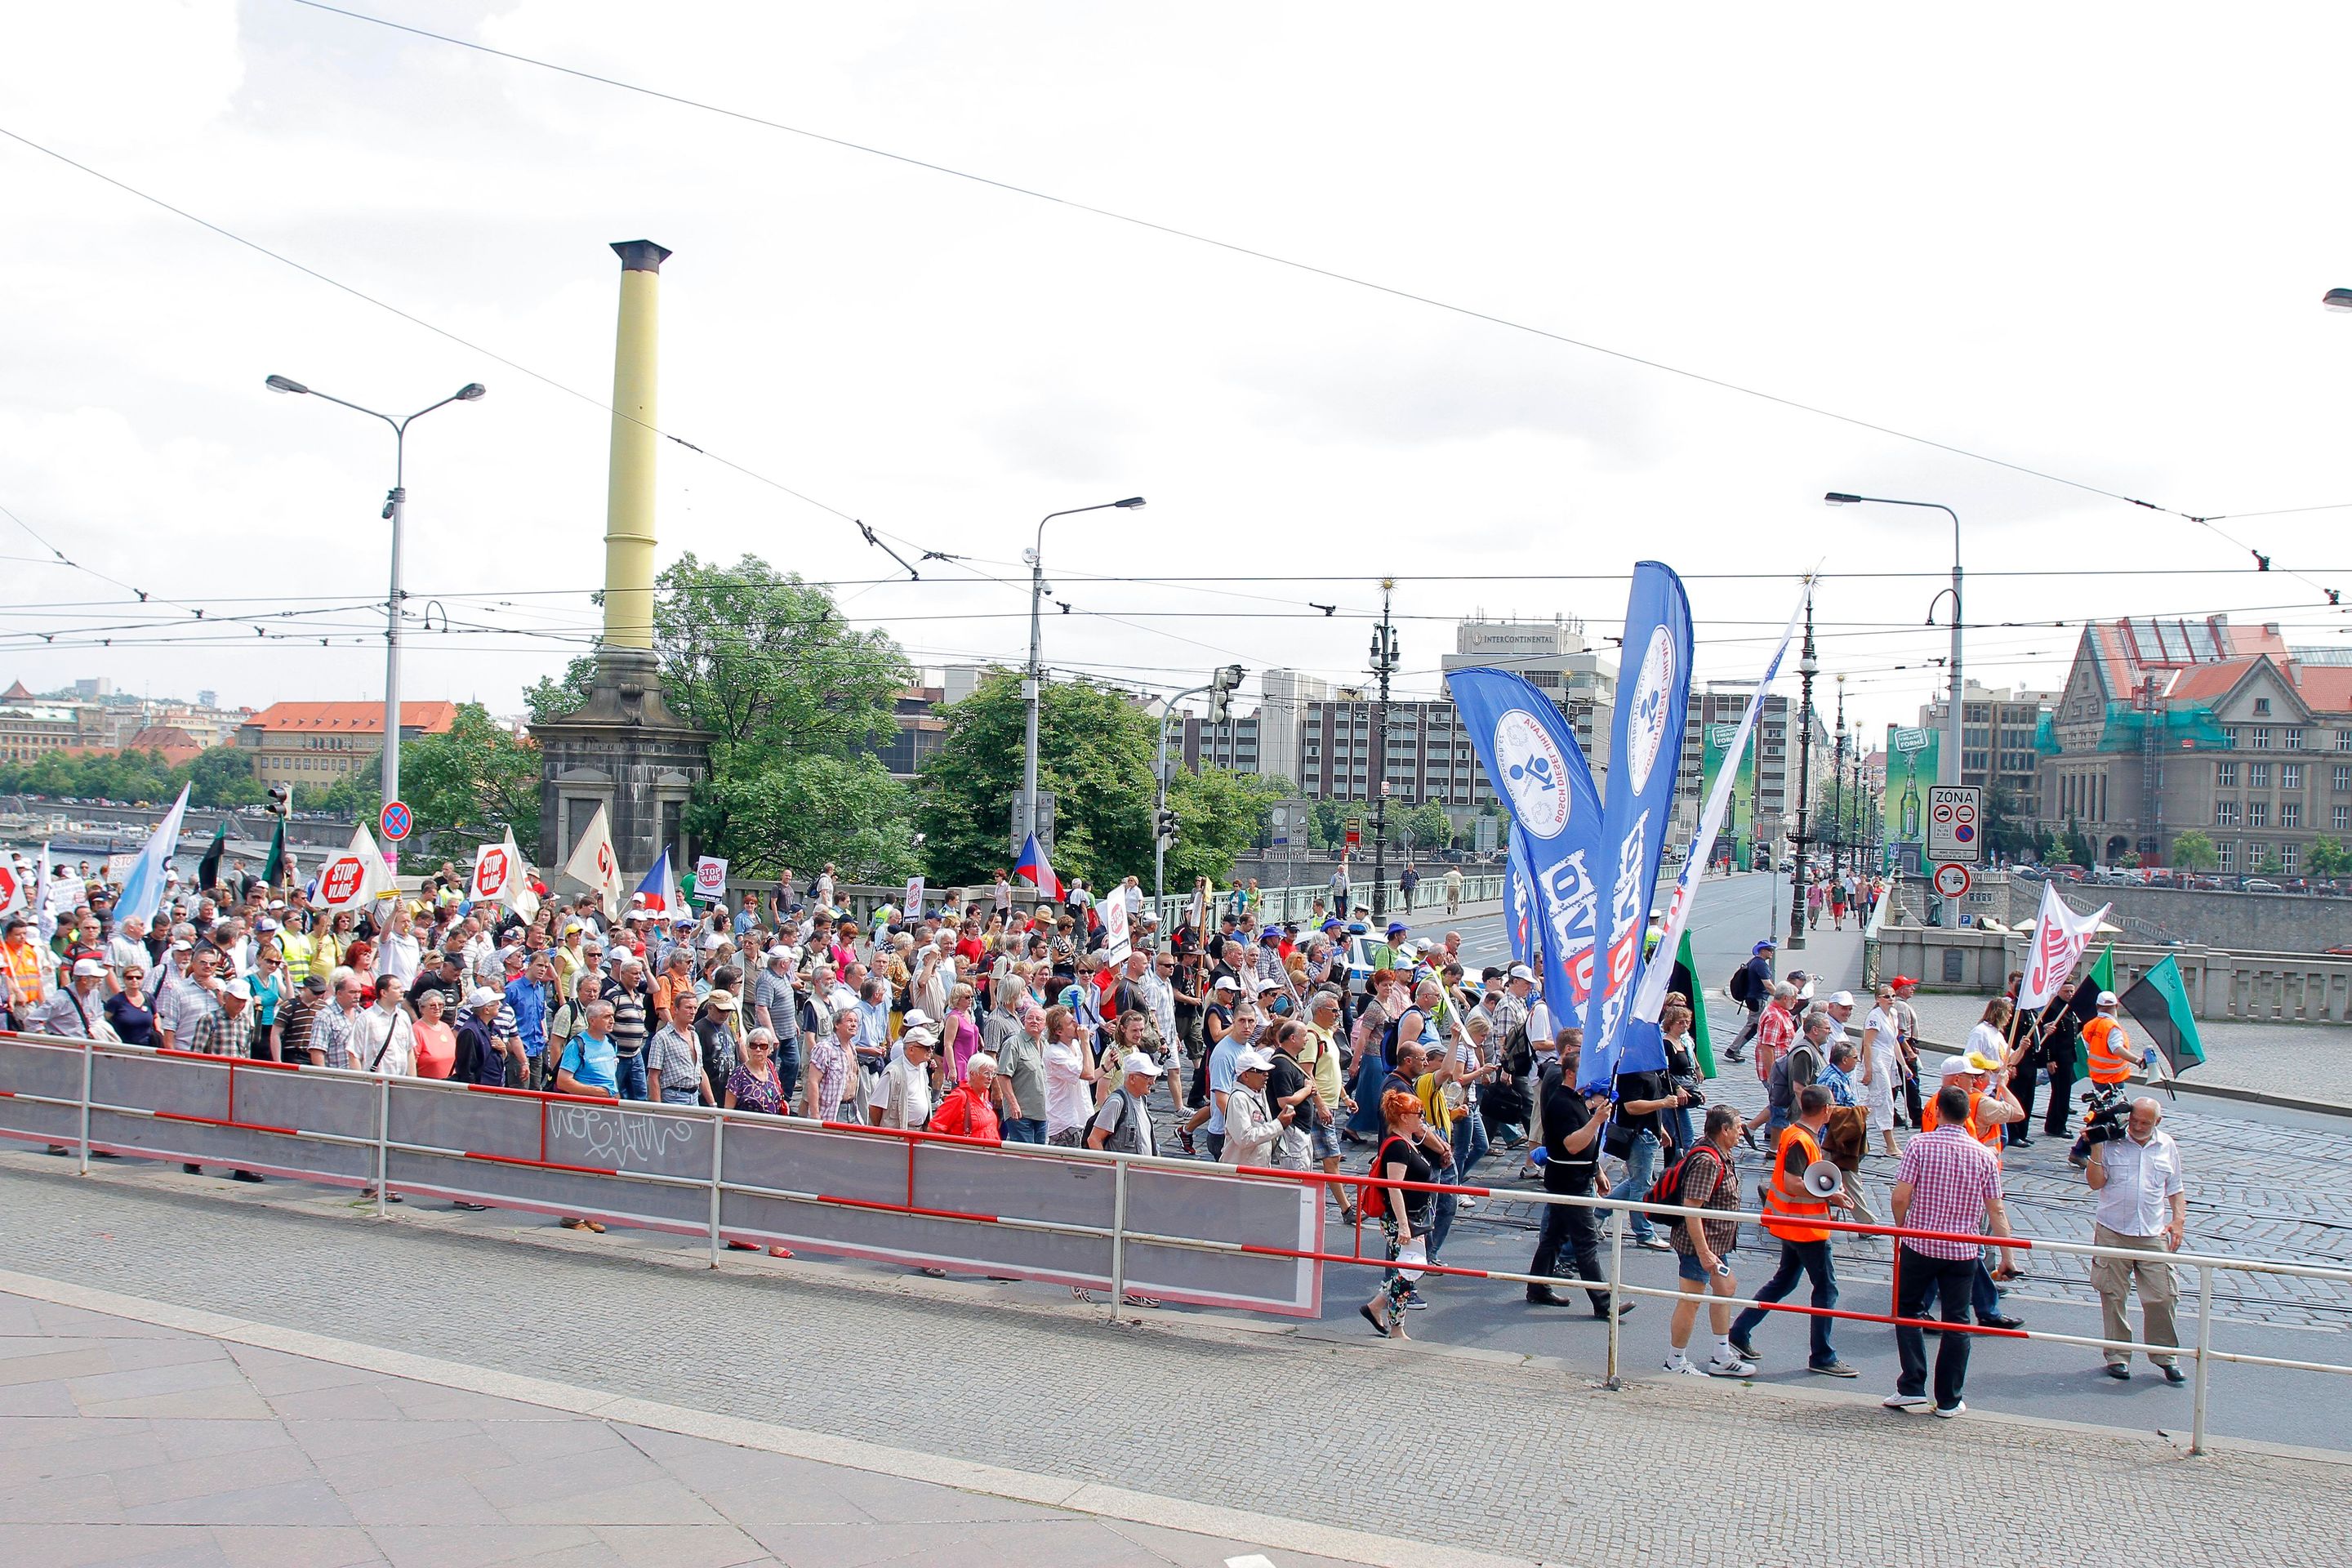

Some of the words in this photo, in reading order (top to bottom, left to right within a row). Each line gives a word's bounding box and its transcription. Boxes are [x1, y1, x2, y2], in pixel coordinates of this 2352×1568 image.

[1936, 790, 1974, 804] ZÓNA
[332, 862, 359, 882] STOP
[483, 853, 503, 875] STOP
[699, 867, 721, 876] STOP
[327, 880, 355, 898] VLÁDĚ
[482, 870, 502, 892] VLÁDĚ
